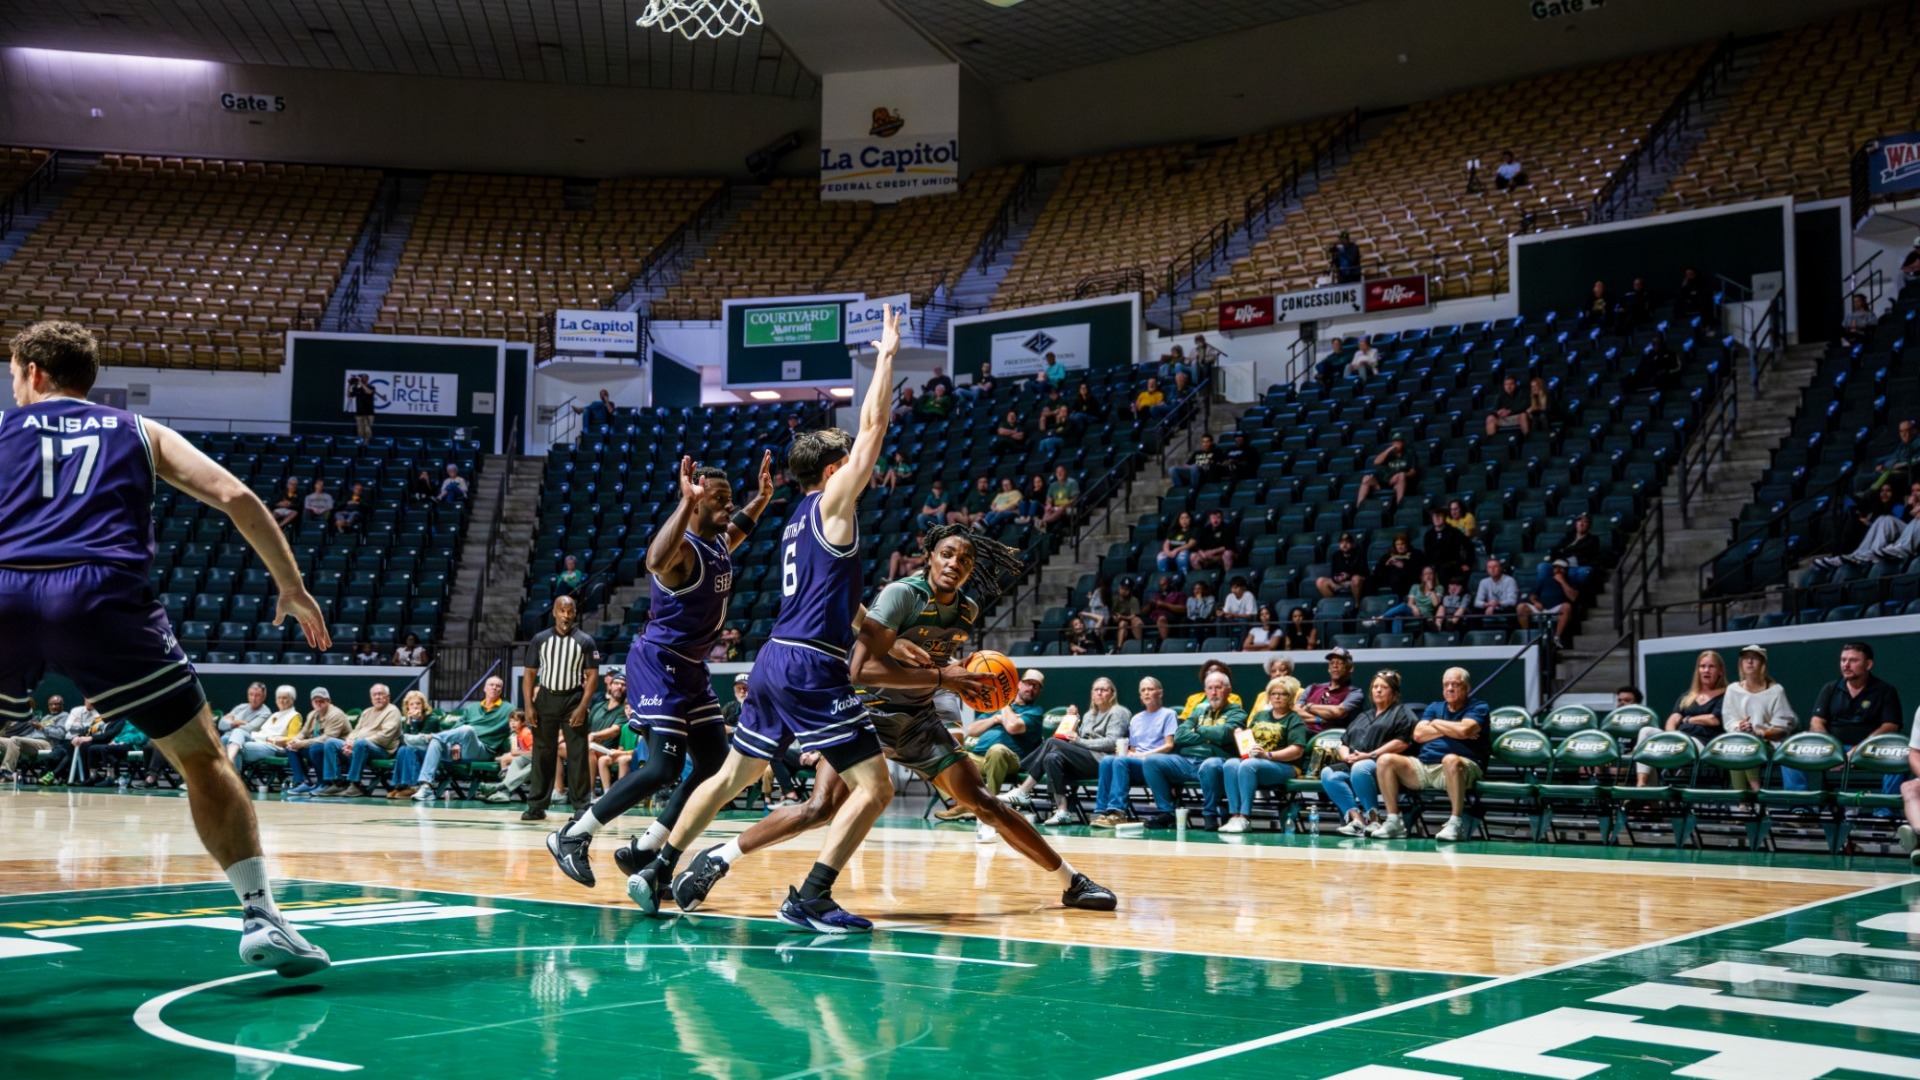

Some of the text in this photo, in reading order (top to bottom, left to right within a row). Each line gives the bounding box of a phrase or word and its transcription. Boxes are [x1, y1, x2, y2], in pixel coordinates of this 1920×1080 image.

[1532, 0, 1584, 20] Gate
[221, 93, 286, 112] Gate 5
[820, 140, 960, 173] La Capitol
[1884, 143, 1920, 171] WA
[820, 176, 959, 193] FEDERAL CREDIT UNION
[1281, 289, 1357, 311] CONCESSIONS
[750, 309, 830, 325] COURTYARD
[848, 311, 862, 324] La
[560, 318, 634, 335] La Capitol
[770, 323, 813, 336] Marriott
[392, 375, 440, 390] FULL
[407, 402, 440, 413] TITLE
[22, 414, 118, 433] ALISAS
[41, 435, 100, 499] 17
[783, 541, 798, 597] 6
[637, 693, 663, 708] Jacks
[830, 694, 860, 716] Jacks
[1551, 713, 1589, 725] Lions
[1611, 713, 1650, 725] Lions
[1315, 738, 1343, 749] Lion
[1502, 736, 1543, 751] Lions
[1565, 738, 1609, 752] Lions
[1644, 740, 1687, 754] Lions
[1712, 741, 1758, 755] Lions
[1786, 742, 1833, 755] Lions
